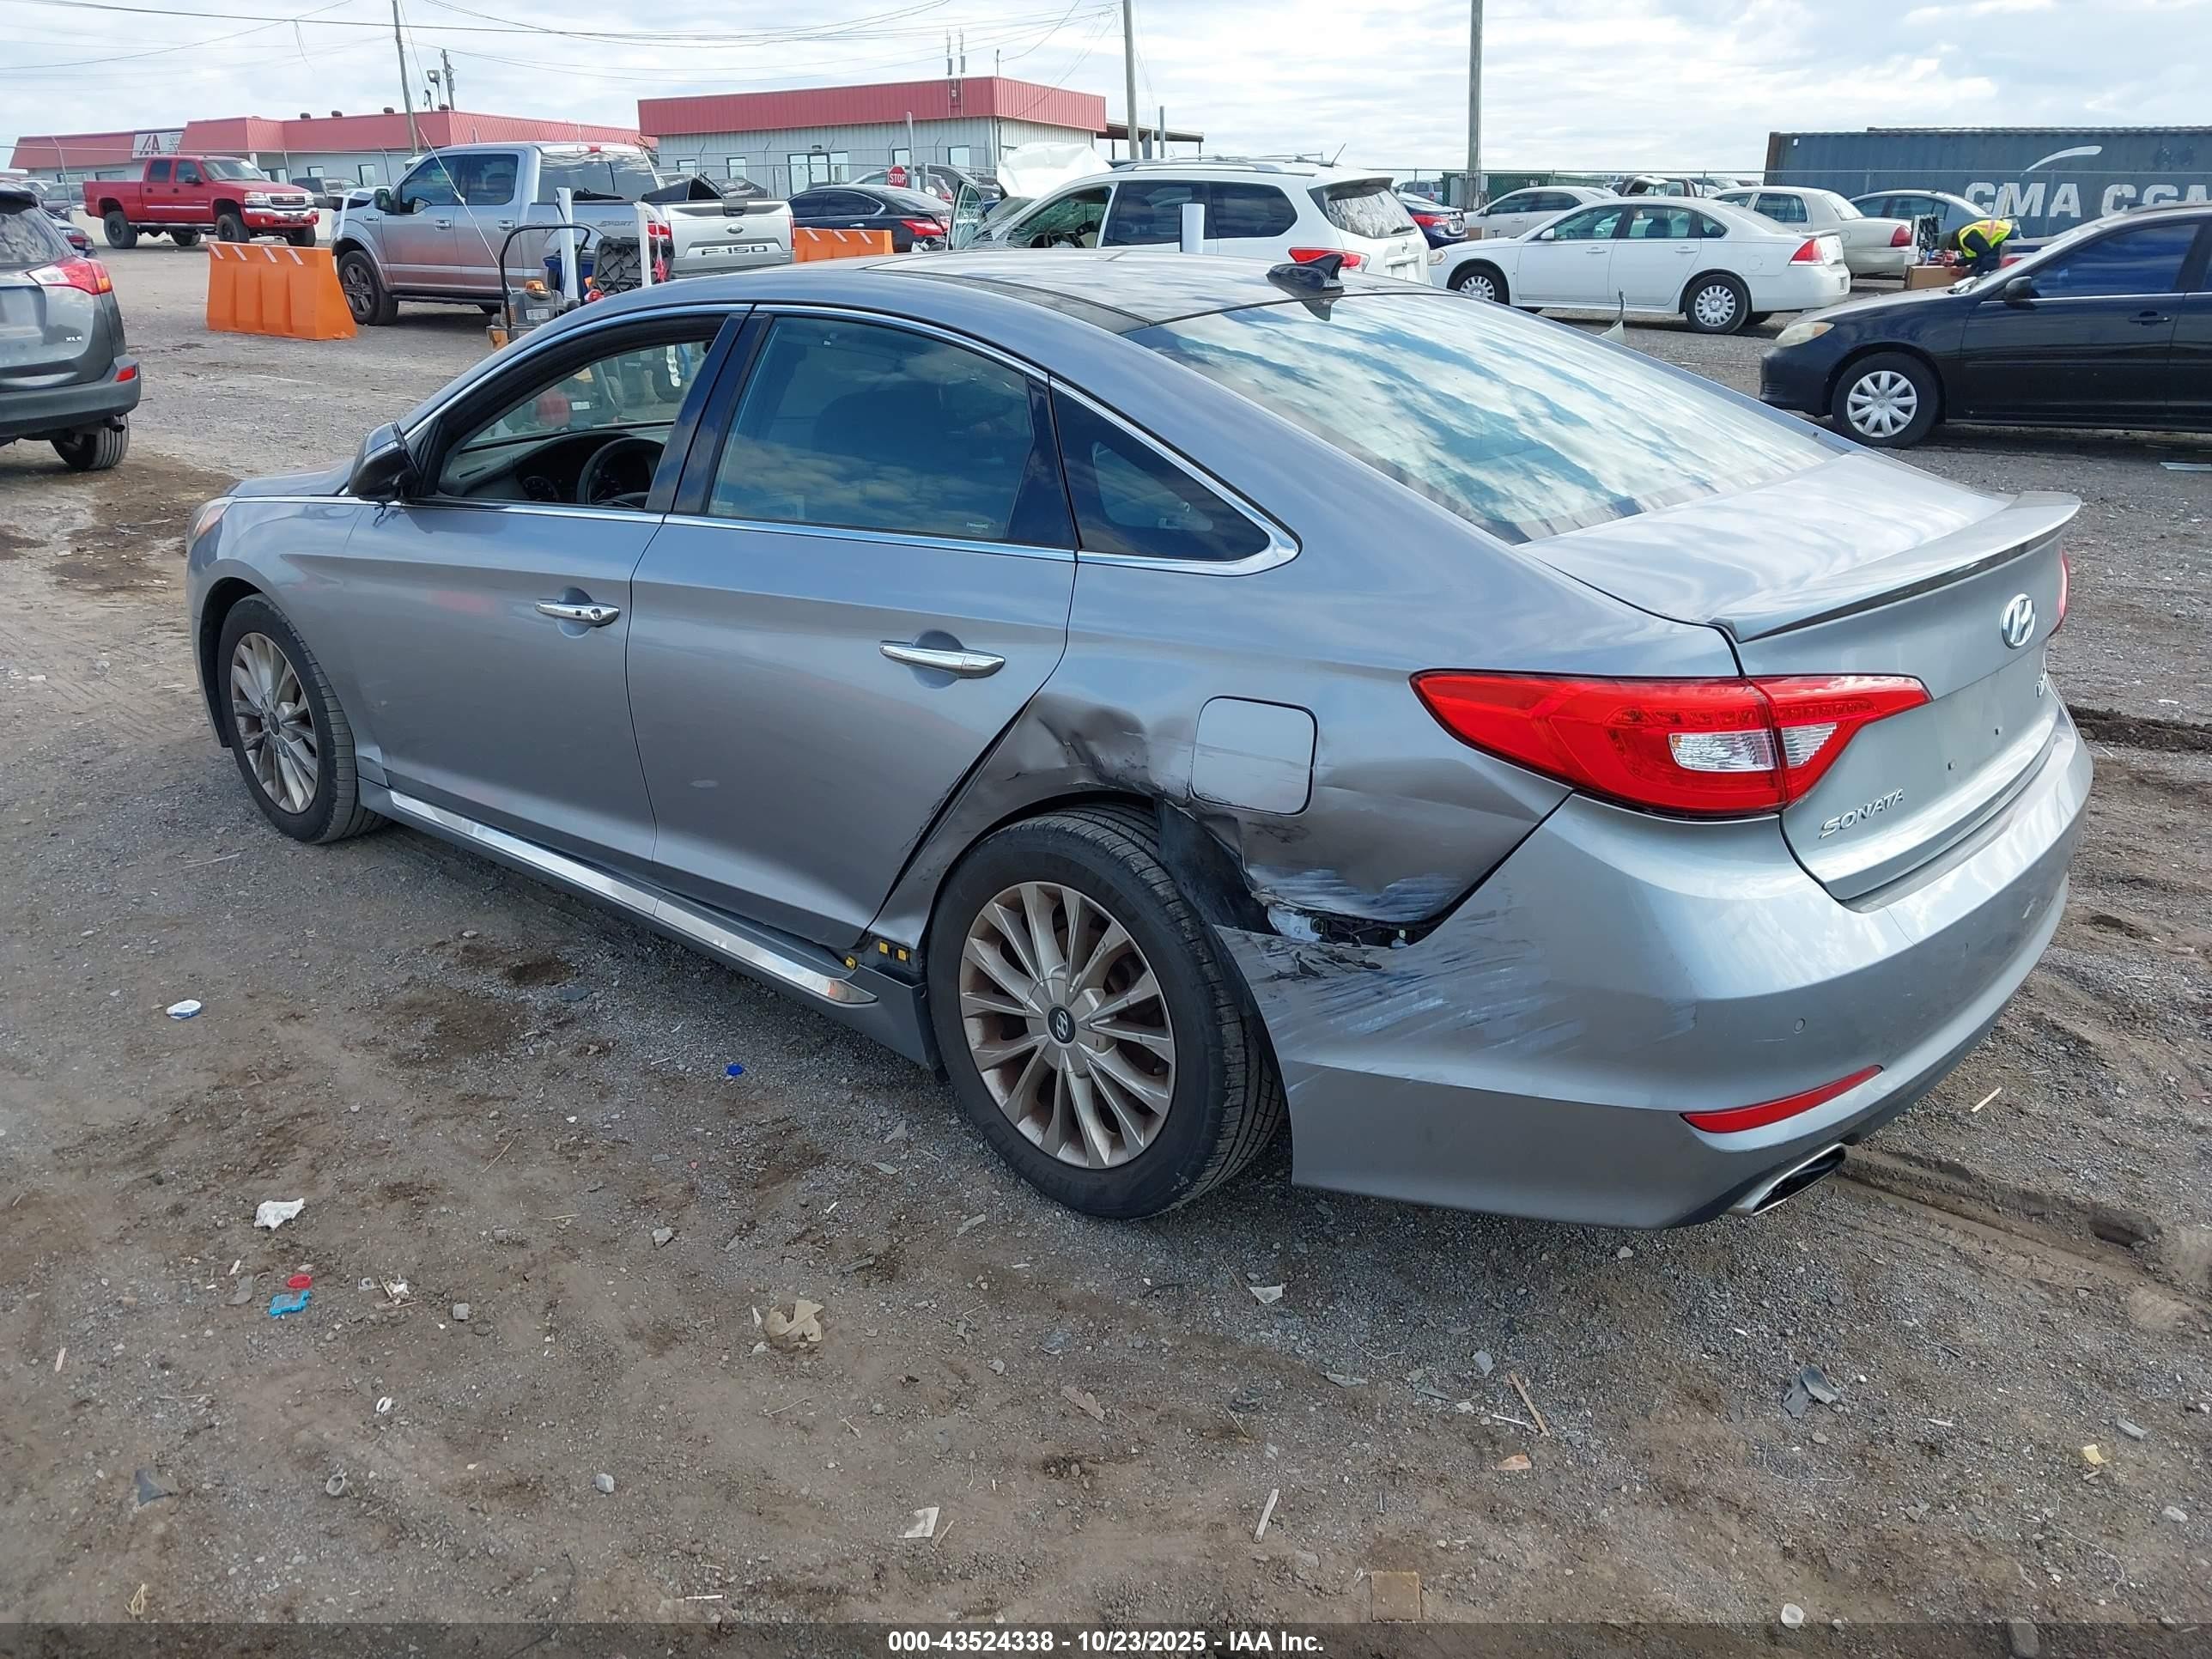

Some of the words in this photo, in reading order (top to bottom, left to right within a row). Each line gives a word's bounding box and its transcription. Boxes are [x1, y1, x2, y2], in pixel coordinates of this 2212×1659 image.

[889, 173, 906, 184] STOP
[1964, 182, 2081, 218] CMA
[701, 244, 769, 257] F-150
[1818, 788, 1904, 840] SONATA
